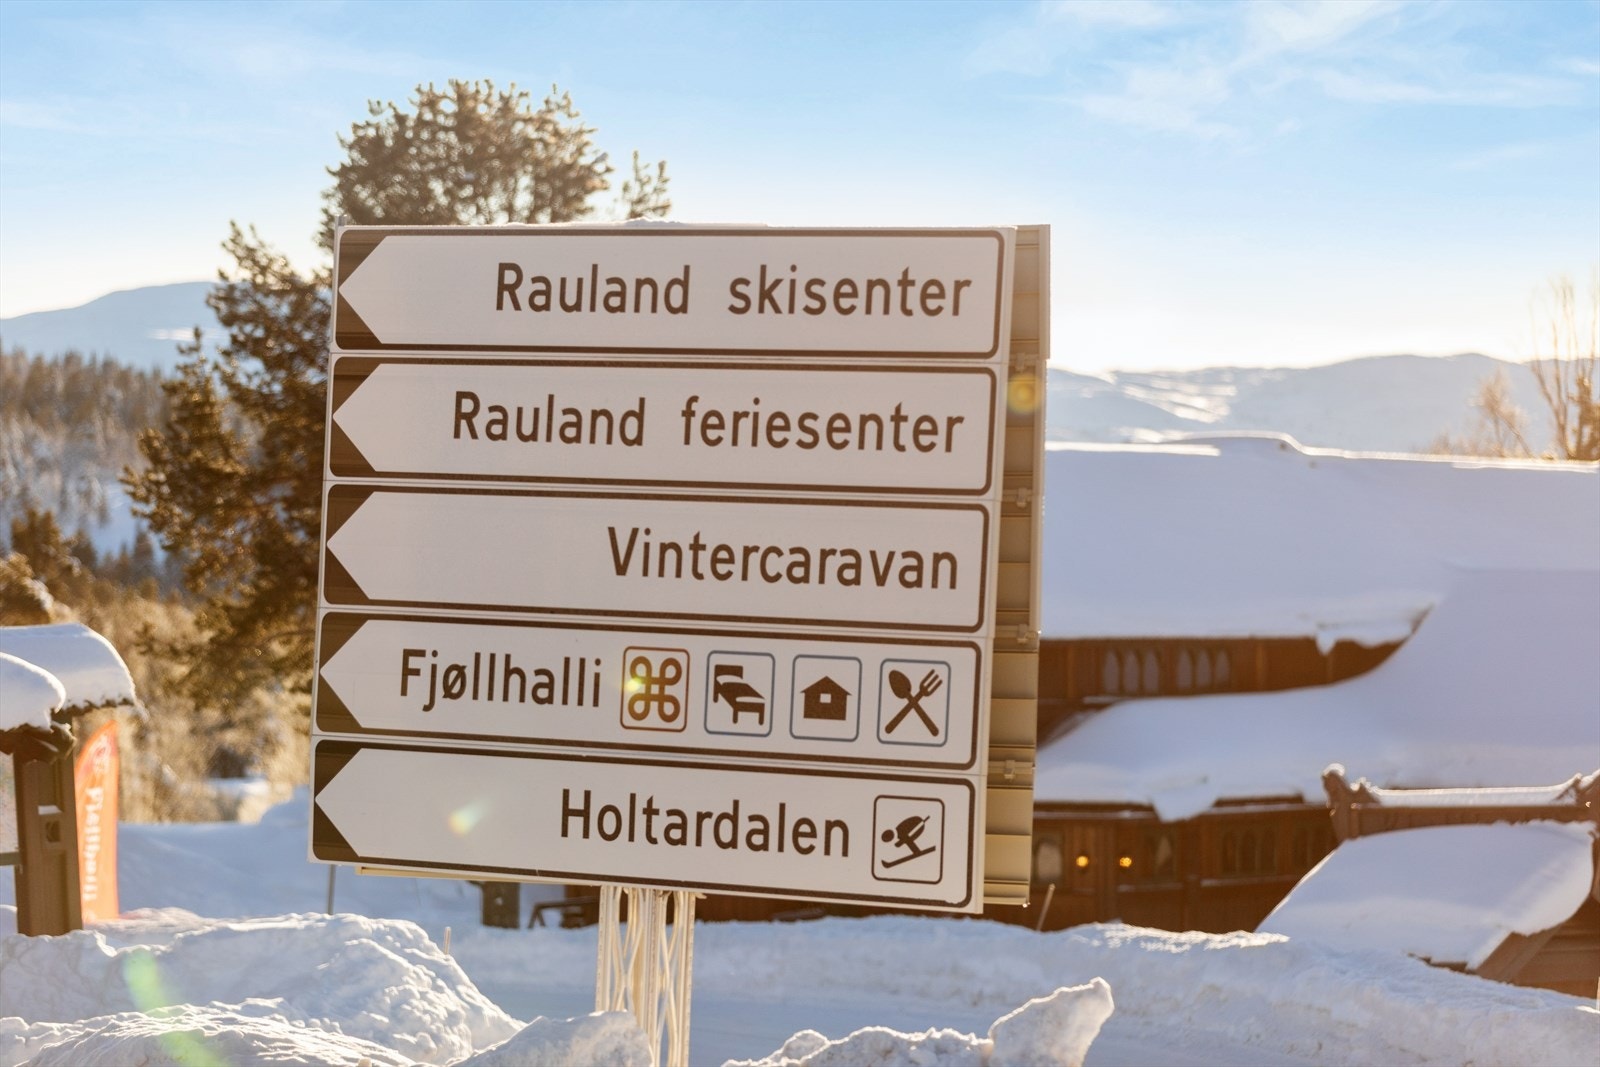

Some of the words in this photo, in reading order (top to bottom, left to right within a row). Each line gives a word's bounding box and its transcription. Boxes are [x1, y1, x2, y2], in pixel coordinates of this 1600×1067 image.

[496, 263, 690, 314] Rauland
[728, 265, 971, 316] skisenter
[454, 391, 646, 446] Rauland
[681, 395, 964, 452] feriesenter
[608, 527, 958, 589] Vintercaravan
[401, 649, 602, 712] Fjøllhalli
[561, 789, 850, 857] Holtardalen
